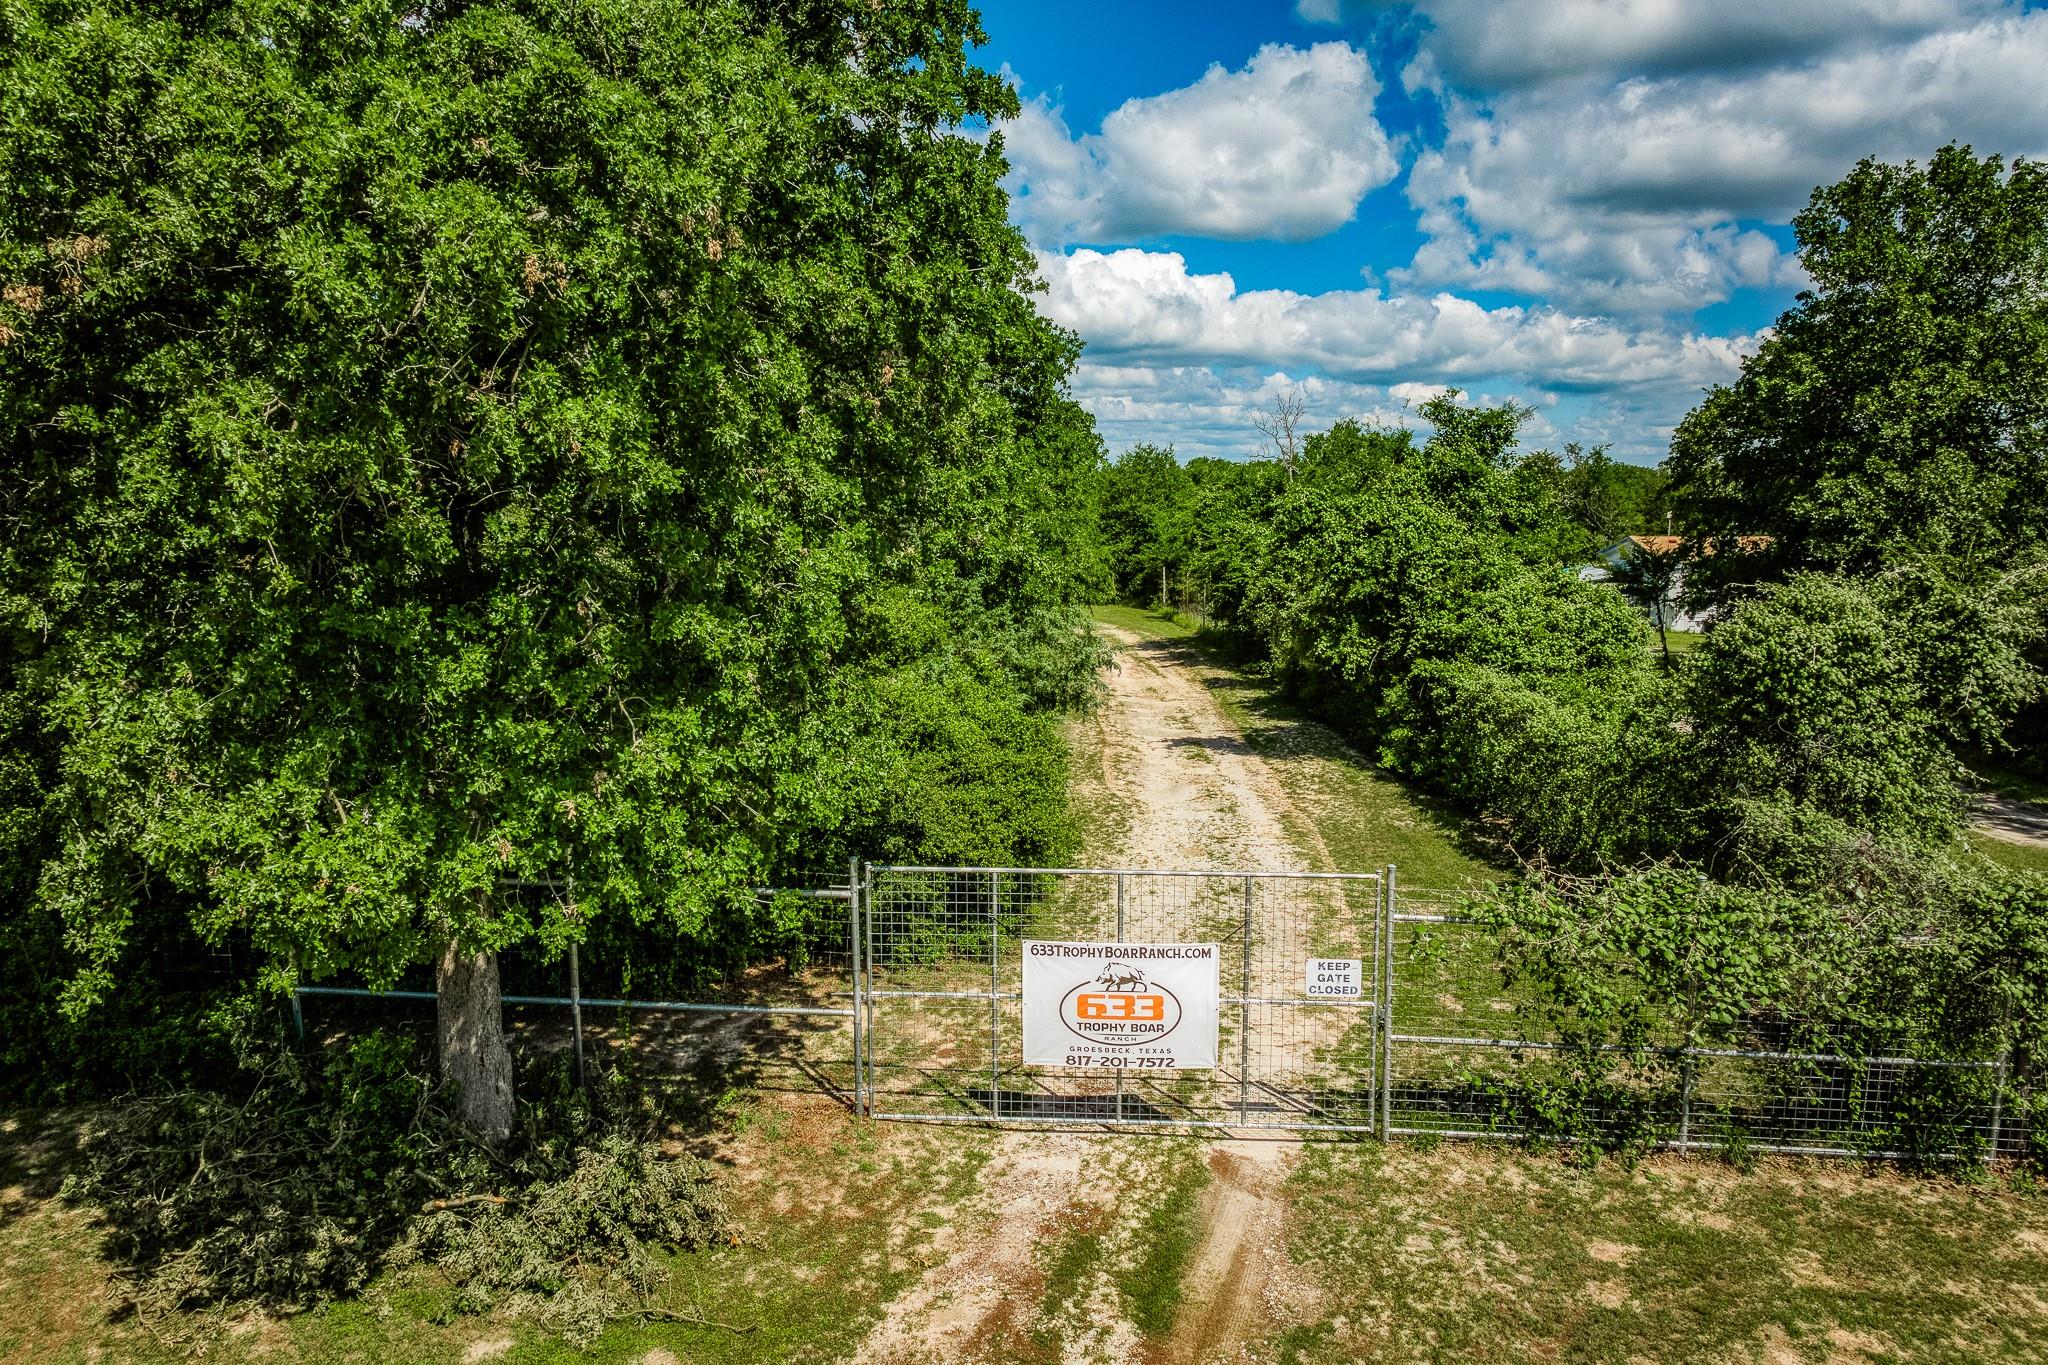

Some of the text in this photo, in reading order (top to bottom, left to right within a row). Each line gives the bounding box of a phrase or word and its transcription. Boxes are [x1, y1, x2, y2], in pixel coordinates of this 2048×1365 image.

[1318, 962, 1350, 970] KEEP
[1318, 974, 1350, 982] GATE
[1309, 986, 1358, 994] CLOSED
[1076, 993, 1165, 1021] 633
[1076, 1022, 1165, 1033] TROPHY BOAR
[1069, 1045, 1135, 1055] GROESBECK,
[1065, 1055, 1175, 1068] 817-201-7572
